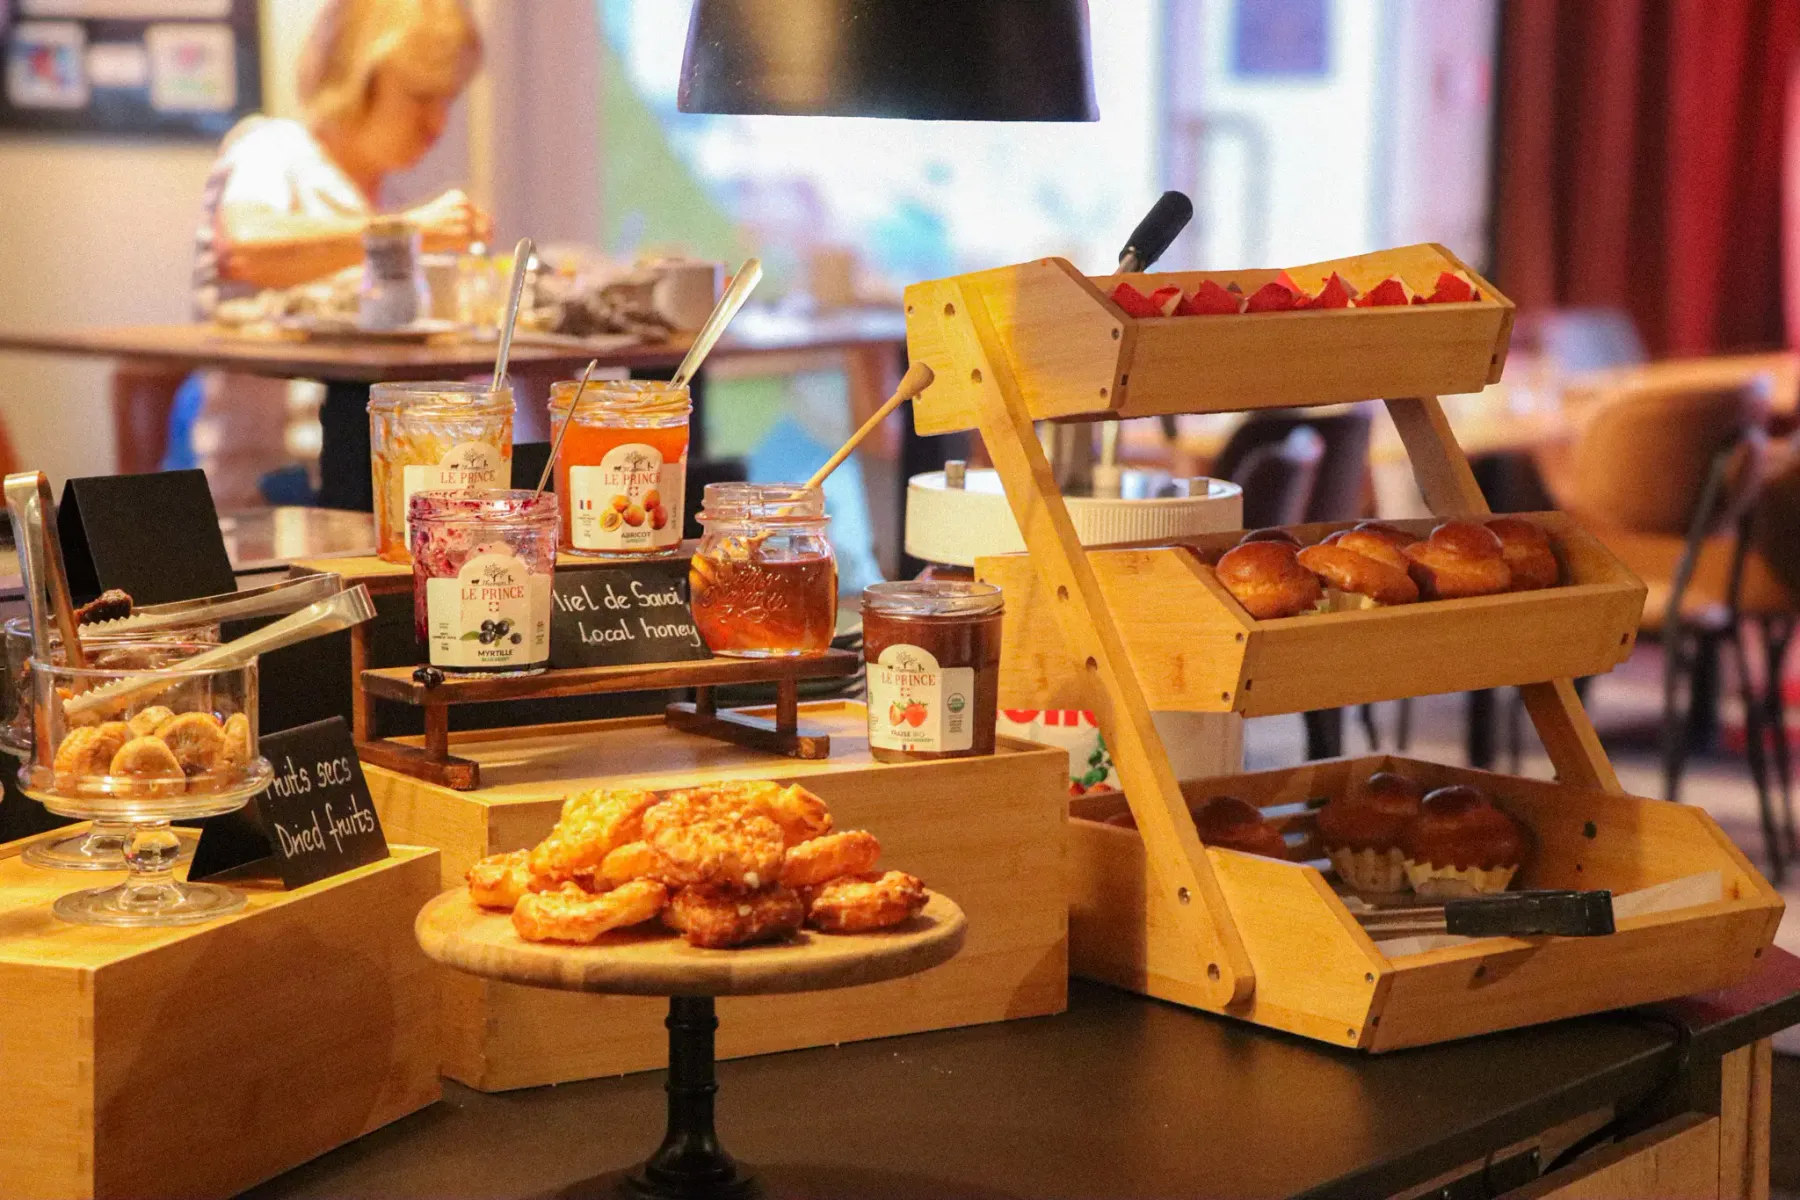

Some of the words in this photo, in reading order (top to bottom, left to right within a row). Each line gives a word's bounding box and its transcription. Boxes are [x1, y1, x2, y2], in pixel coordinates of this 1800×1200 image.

[440, 471, 456, 484] LE
[460, 469, 496, 484] PRINCE
[604, 473, 619, 486] LE
[623, 471, 662, 486] PRINCE
[621, 531, 652, 539] ABRICOT
[461, 587, 477, 601] LE
[481, 585, 525, 601] PRINCE
[603, 583, 632, 610] de
[578, 617, 636, 643] Local
[639, 617, 701, 648] honey
[477, 649, 514, 657] MYRTILLE
[881, 672, 893, 685] LE
[895, 673, 937, 687] PRINCE
[316, 756, 352, 788] secs
[274, 810, 327, 859] Dried
[325, 794, 375, 854] fruits
